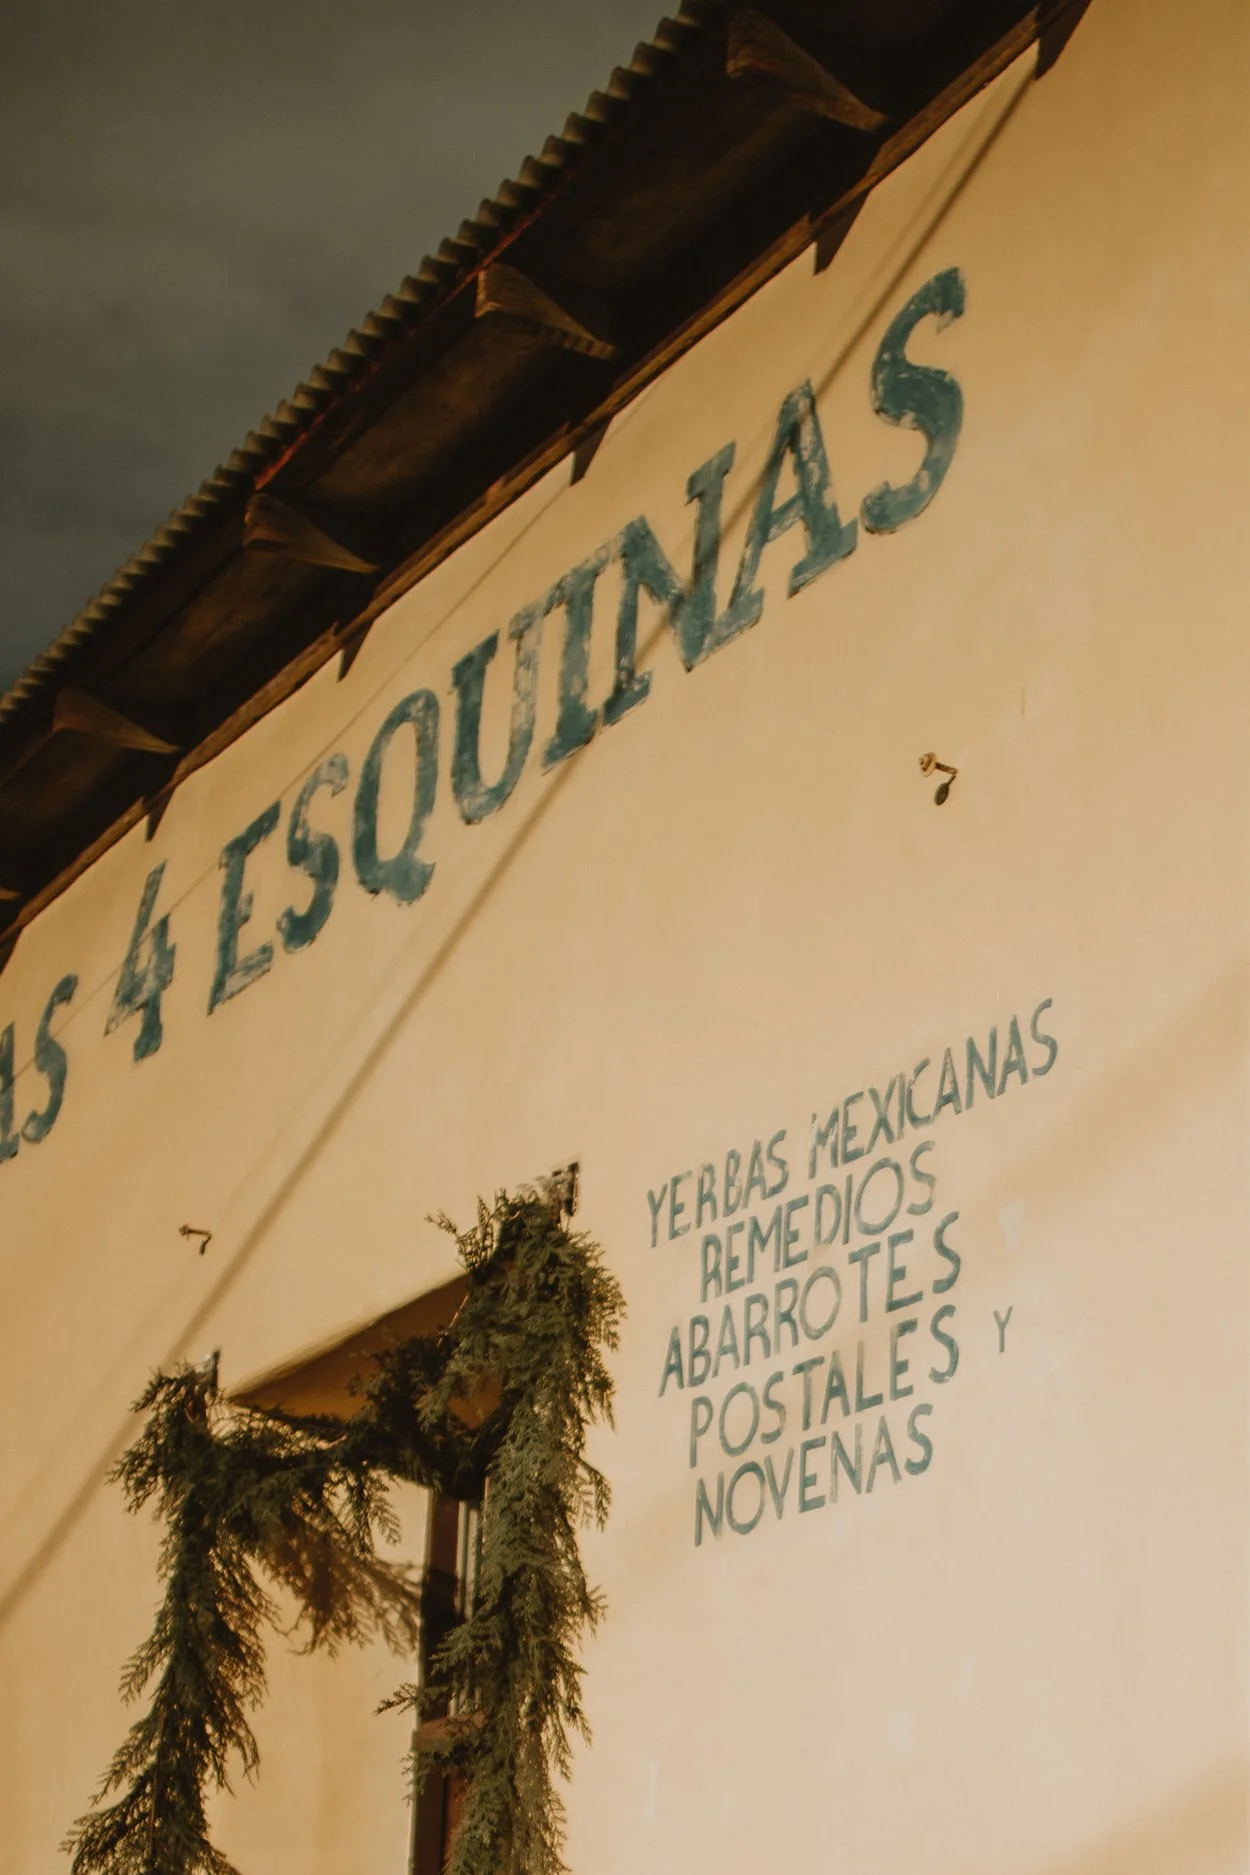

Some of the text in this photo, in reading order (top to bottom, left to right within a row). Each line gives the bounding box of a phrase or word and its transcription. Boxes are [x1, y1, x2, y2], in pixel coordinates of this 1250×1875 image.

[104, 859, 176, 1062] 4
[207, 267, 966, 1015] ESQUINAS
[646, 997, 1060, 1248] YERBAS MEXICANAS
[657, 1211, 961, 1397] ABARROTES
[700, 1140, 936, 1303] REMEDIOS
[688, 1304, 1013, 1469] POSTALES Y
[694, 1402, 935, 1547] NOVENAS
